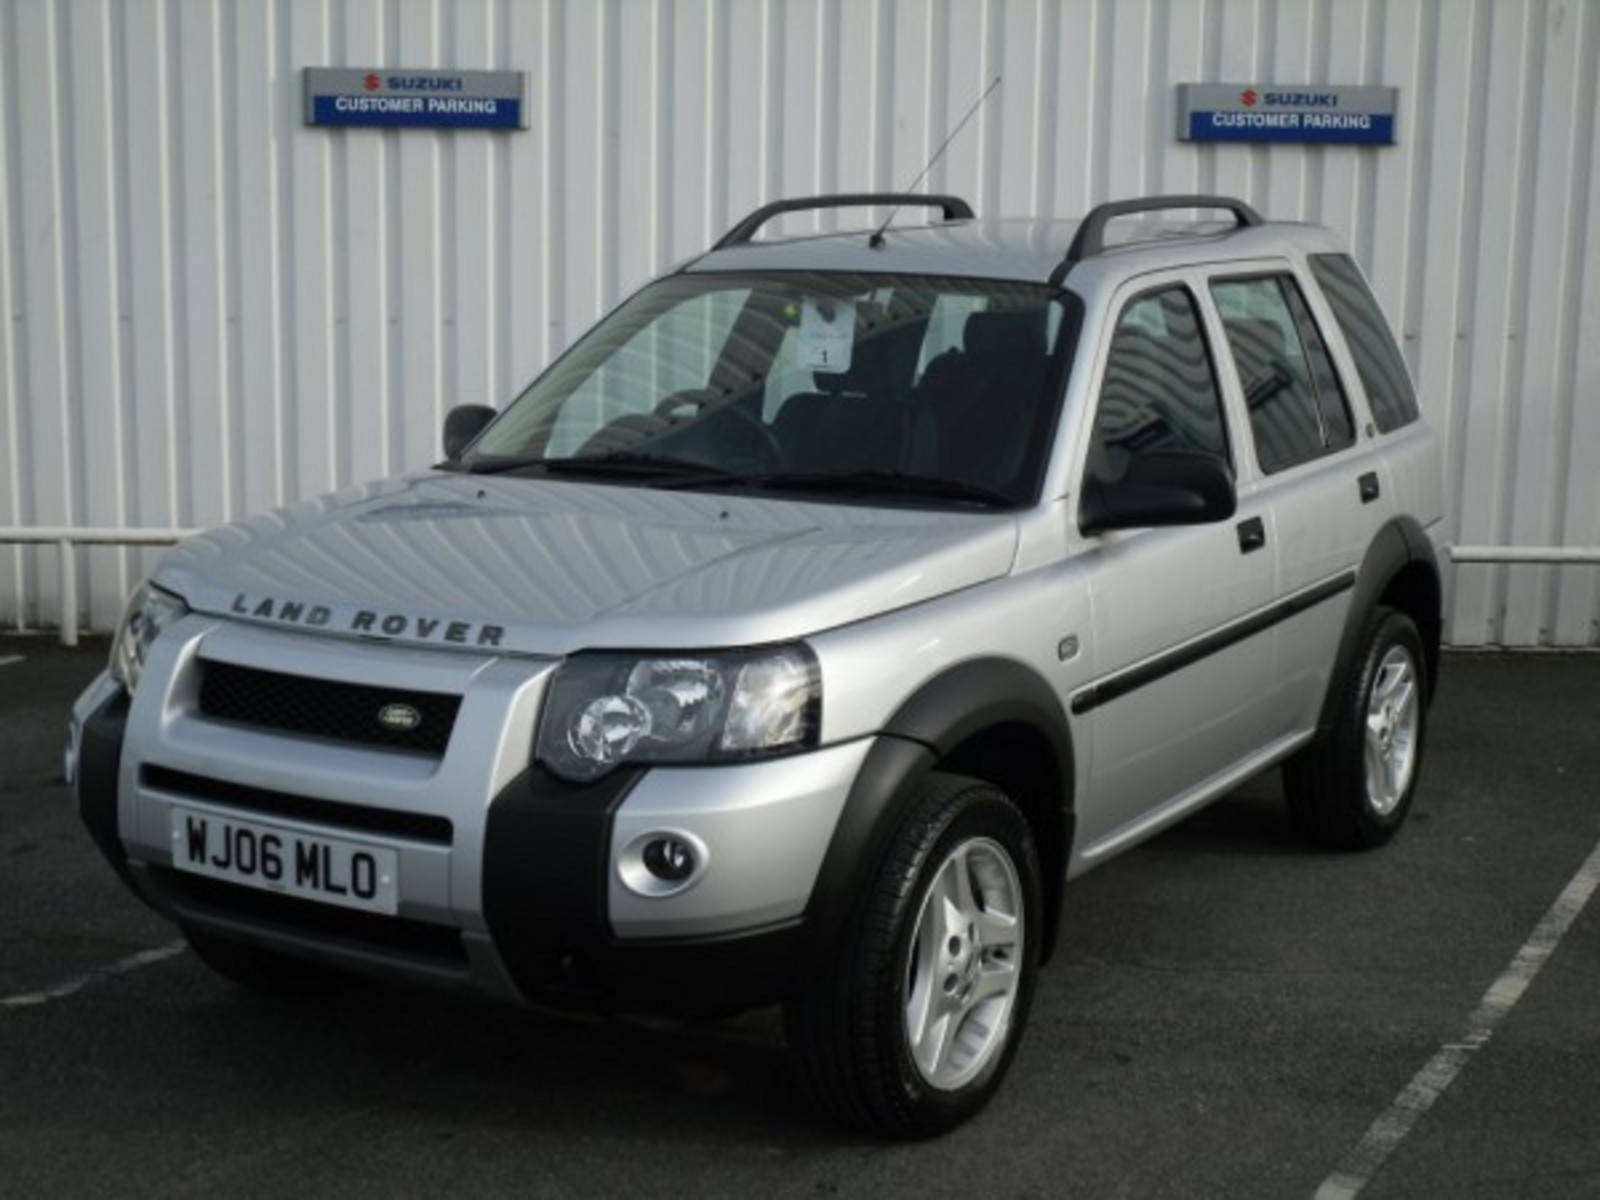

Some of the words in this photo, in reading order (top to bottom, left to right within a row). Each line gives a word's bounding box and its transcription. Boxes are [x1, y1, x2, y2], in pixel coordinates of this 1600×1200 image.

[387, 76, 462, 91] SUZUKI
[335, 96, 424, 112] CUSTOMER
[428, 99, 497, 114] PARKING
[1263, 92, 1338, 107] SUZUKI
[1212, 112, 1300, 128] CUSTOMER
[1303, 114, 1371, 129] PARKING
[231, 594, 333, 626] LAND
[352, 610, 506, 646] ROVER
[186, 815, 283, 881] WJ06
[295, 839, 377, 900] MLO
